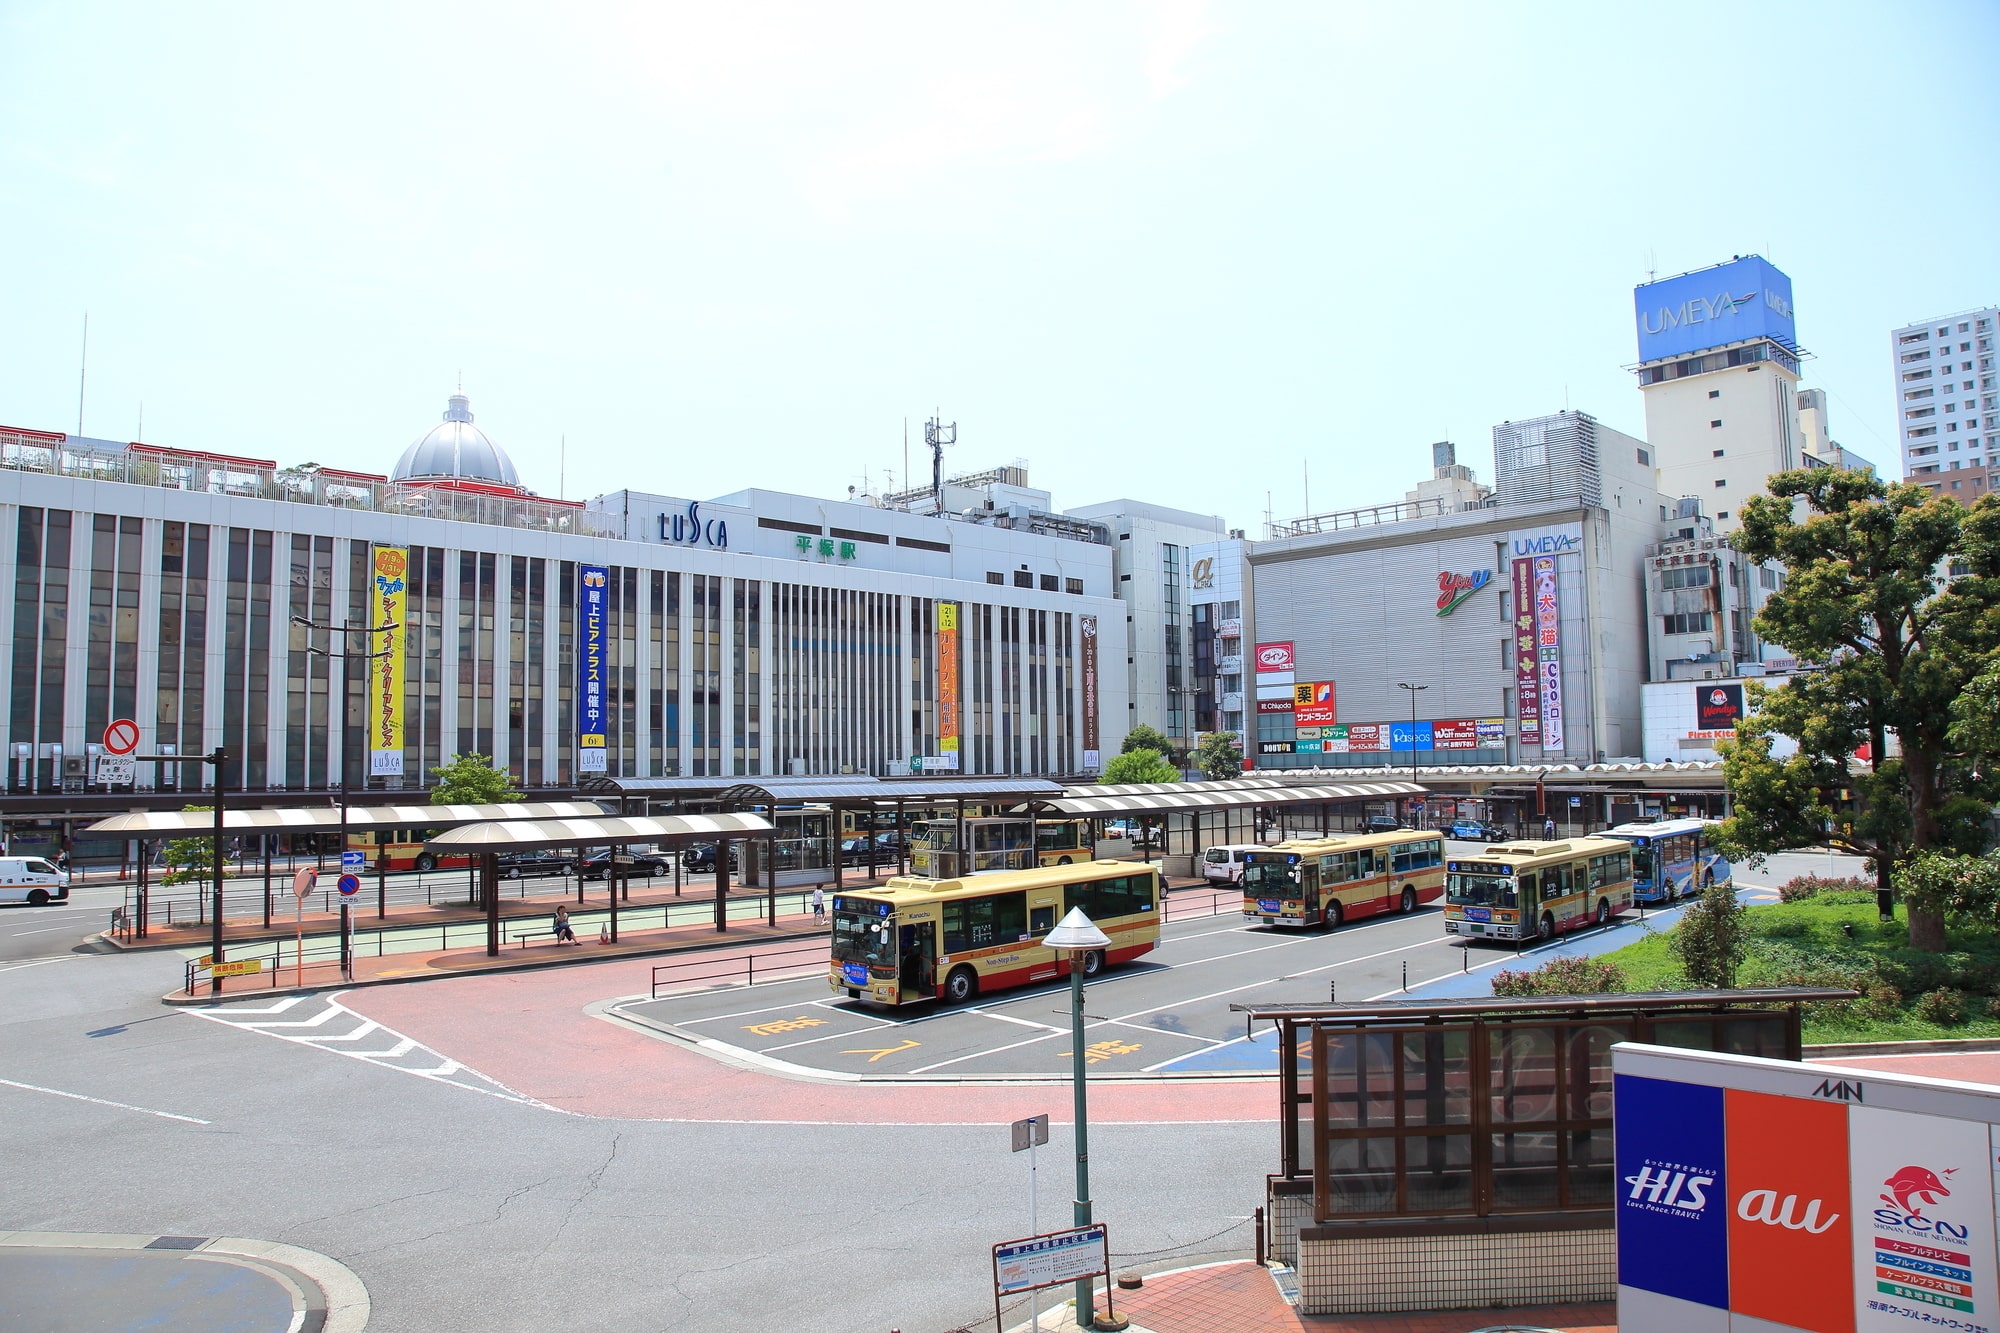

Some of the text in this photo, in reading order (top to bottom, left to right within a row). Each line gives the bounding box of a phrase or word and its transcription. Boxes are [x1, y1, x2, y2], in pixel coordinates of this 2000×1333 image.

[1642, 292, 1738, 334] UMEYA
[661, 501, 728, 547] LUSCA
[796, 535, 856, 560] 平塚駅
[1514, 534, 1571, 555] UMEYA
[377, 575, 404, 596] ラスカ
[1539, 594, 1554, 610] 犬
[1541, 629, 1557, 646] 猫
[1263, 652, 1288, 662] ダイソー
[1298, 686, 1311, 703] 薬
[1267, 702, 1291, 710] Chiyoda
[1297, 712, 1333, 722] サンドラッグ
[588, 736, 598, 744] 6F
[1688, 731, 1712, 739] First
[1264, 743, 1291, 752] DOUTOR
[374, 753, 400, 767] LUSCA
[582, 751, 604, 764] LUSCA
[1009, 955, 1020, 963] Bus
[214, 964, 244, 972] 横断危険
[1645, 1159, 1717, 1176] もっと世界を楽しもう
[1671, 1208, 1701, 1220] TRAVEL
[1737, 1189, 1840, 1234] au
[1873, 1209, 1968, 1239] SCN
[1873, 1223, 1968, 1246] SHONAN CABLE NETWORK
[1013, 1233, 1089, 1255] 路上喫煙禁止区域
[1892, 1242, 1951, 1261] ケーブルテレビ
[1877, 1254, 1969, 1279] ケーブルインターネット
[1886, 1270, 1962, 1294] ケーブルプラス電話
[1894, 1286, 1955, 1308] 緊急地震速報
